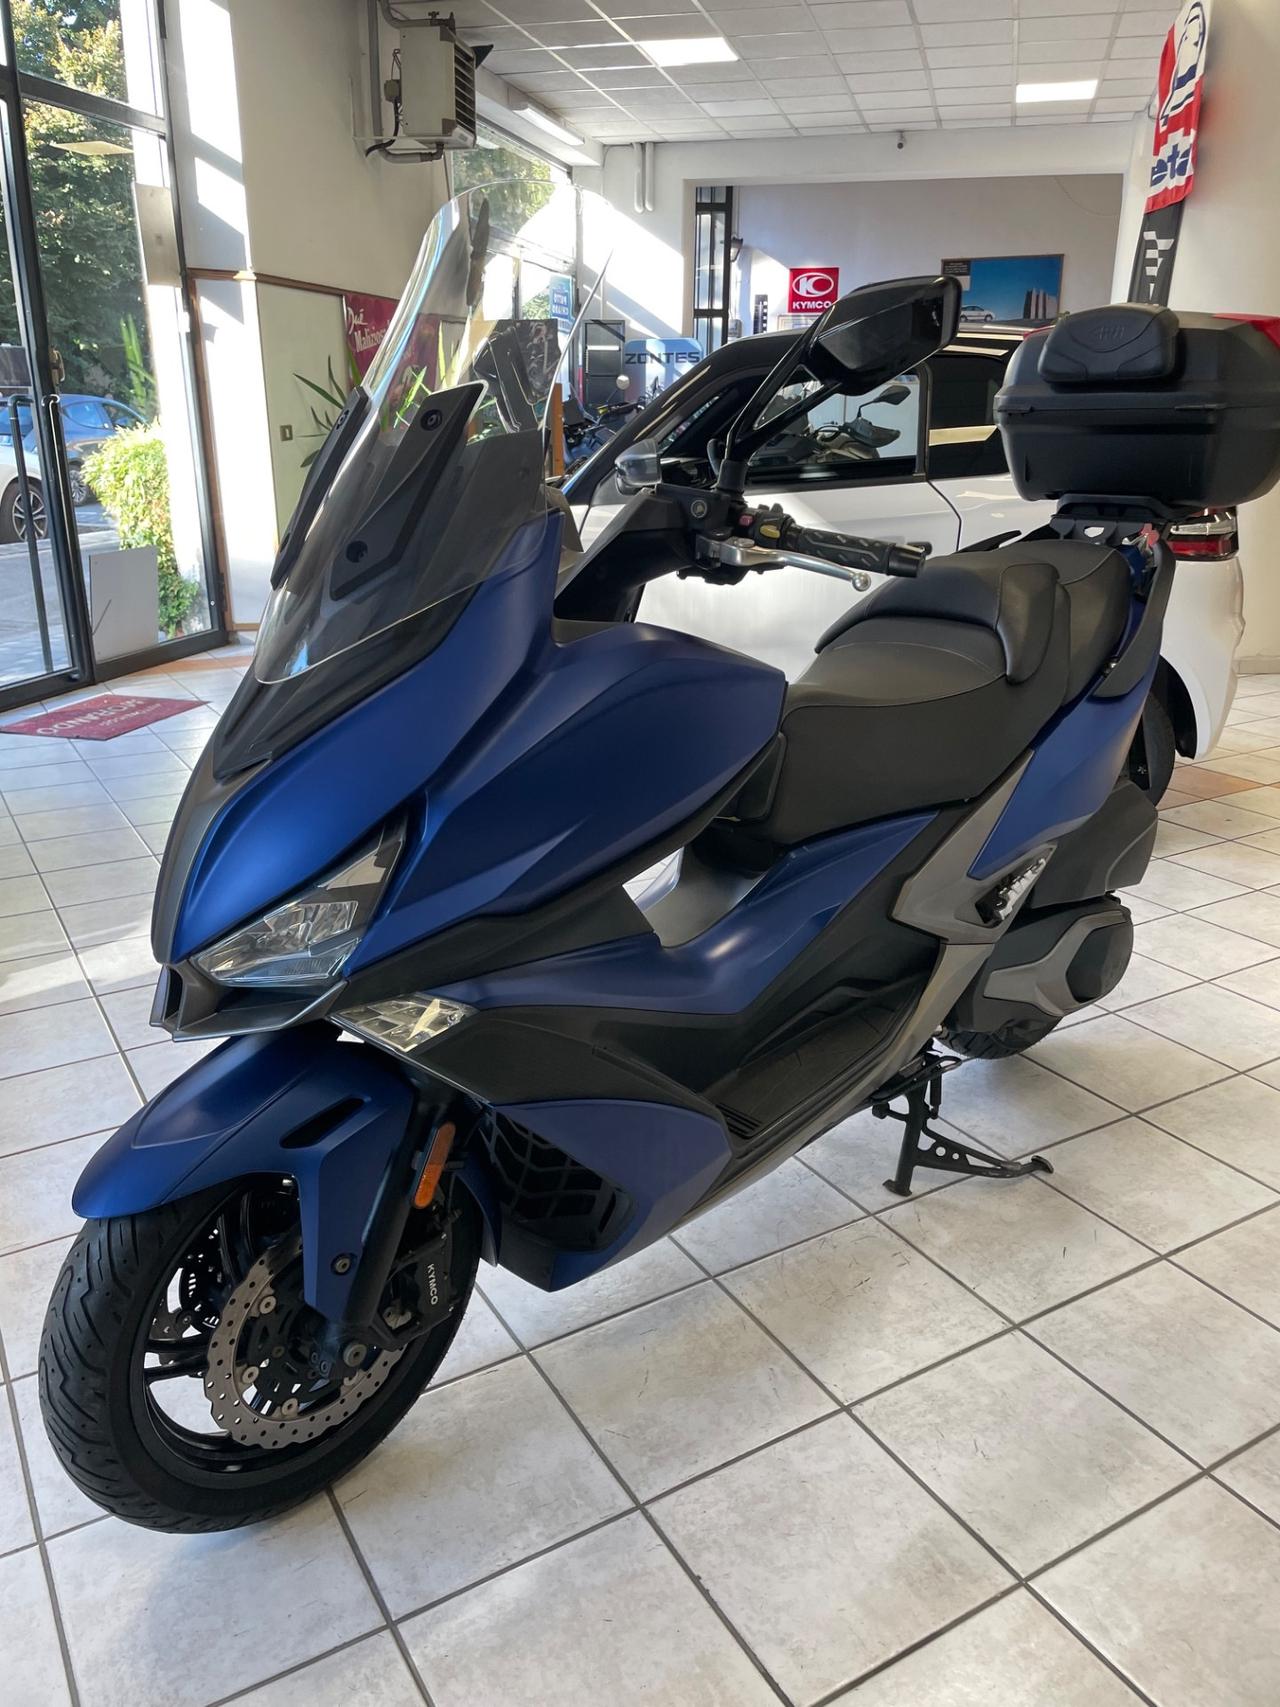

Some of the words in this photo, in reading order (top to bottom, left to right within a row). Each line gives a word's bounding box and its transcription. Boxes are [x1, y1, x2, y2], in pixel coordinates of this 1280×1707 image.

[792, 301, 832, 309] KYMCO
[624, 351, 701, 365] ZONTES
[427, 1263, 439, 1305] KYMCO
